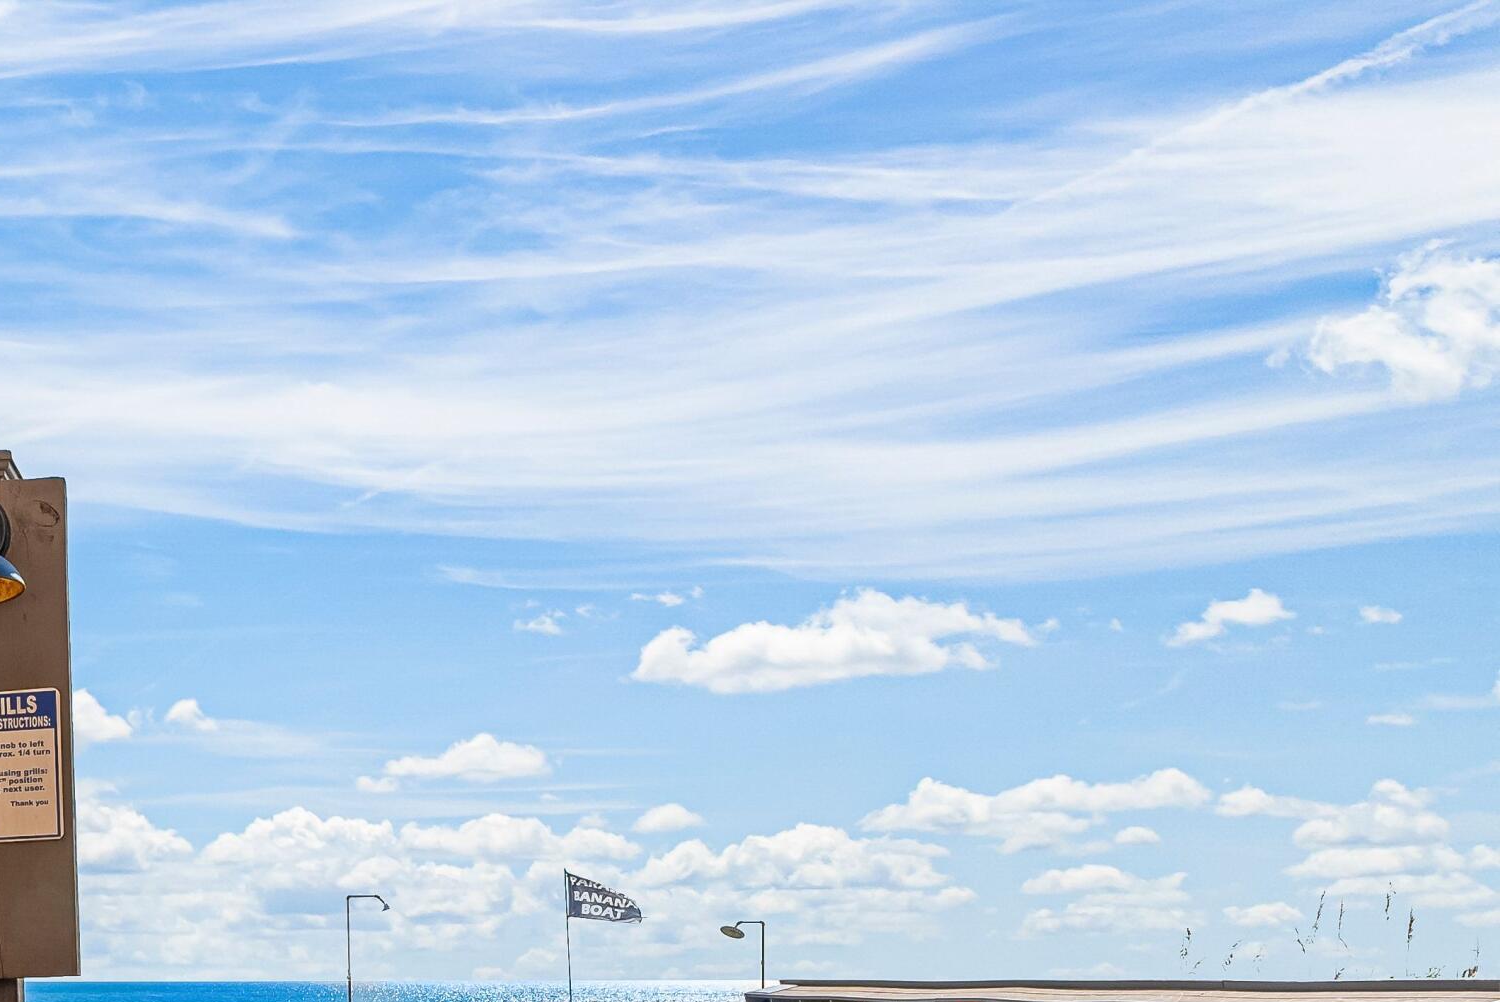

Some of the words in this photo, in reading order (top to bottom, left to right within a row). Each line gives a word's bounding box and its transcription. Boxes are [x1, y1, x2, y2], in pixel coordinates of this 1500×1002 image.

[29, 740, 45, 748] left
[33, 748, 51, 756] turn
[23, 767, 48, 777] grills:
[8, 776, 43, 785] position
[10, 799, 34, 807] Thank
[35, 799, 49, 807] you
[573, 890, 637, 909] BANANA
[581, 903, 625, 920] BOAT
